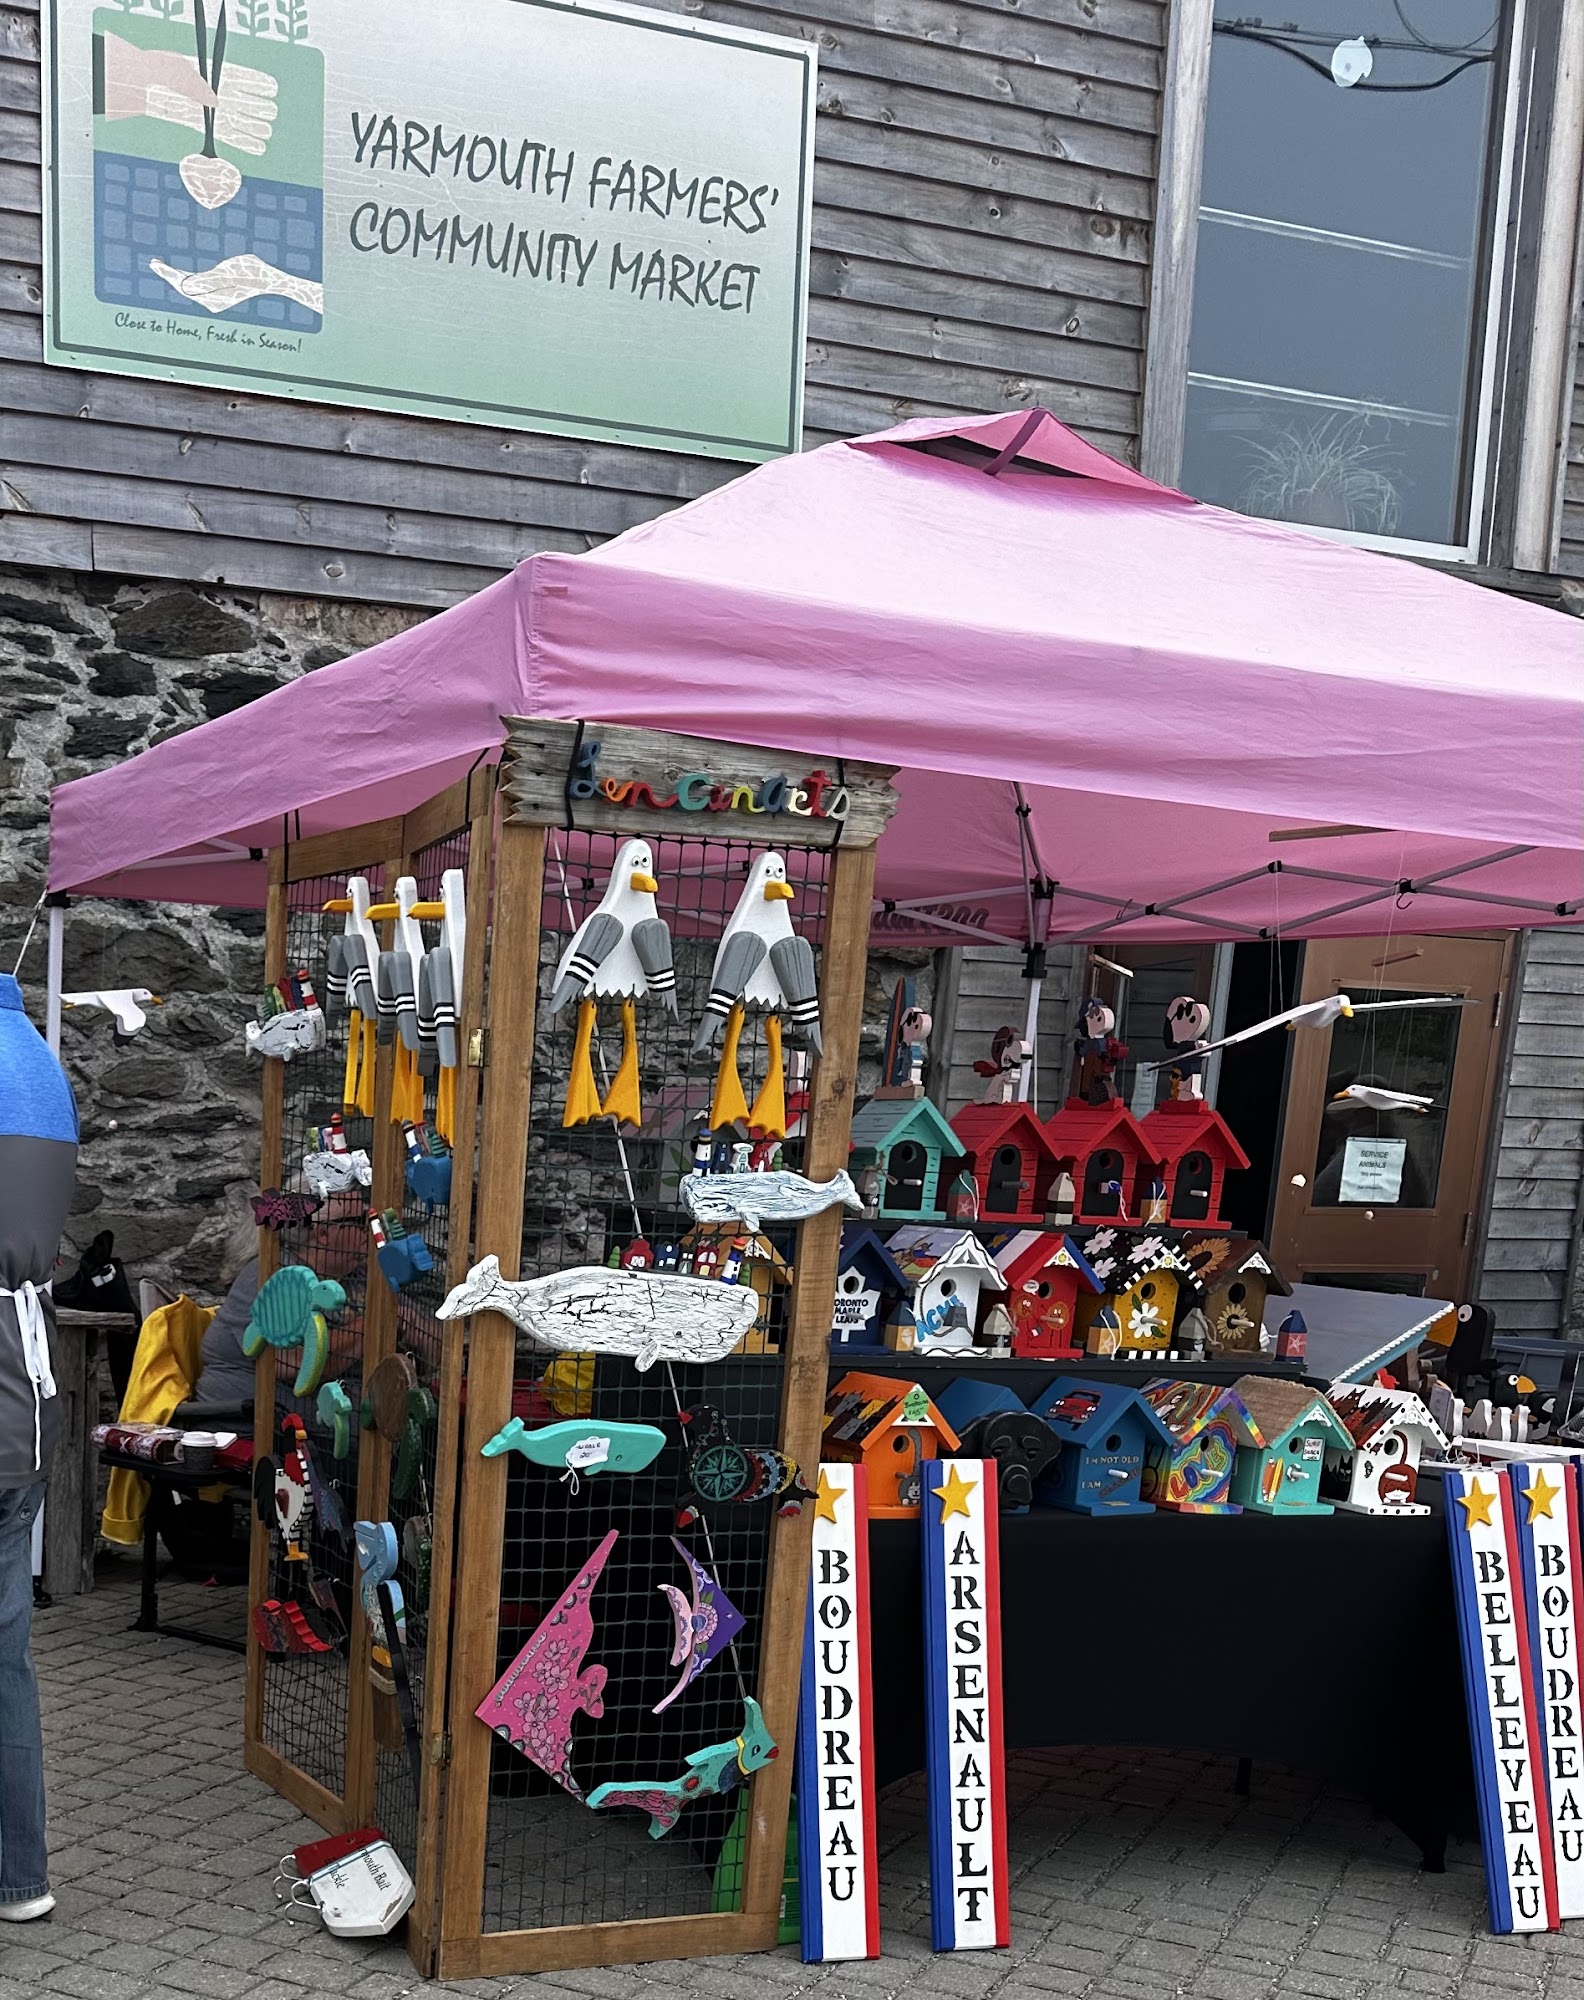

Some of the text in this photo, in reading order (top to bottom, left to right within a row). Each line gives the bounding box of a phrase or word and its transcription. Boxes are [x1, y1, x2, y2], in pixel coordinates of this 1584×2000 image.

[352, 112, 779, 234] YARMOUTH FARMERS'
[350, 202, 760, 313] COMMUNITY MARKET
[115, 312, 302, 353] Close to Home, Fresh in Season!
[1358, 1160, 1387, 1169] ANIMALS
[1360, 1150, 1389, 1159] SERVICE
[834, 1298, 869, 1307] ORONTO
[1100, 1456, 1119, 1464] NOT
[1121, 1455, 1140, 1464] OLD
[1087, 1480, 1101, 1489] AM
[1537, 1544, 1583, 1862] BOUDREAU
[817, 1548, 856, 1903] BOUDREAU
[948, 1530, 989, 1922] ARSENAULT
[1475, 1550, 1541, 1919] BELLEVEAU
[373, 1871, 392, 1891] Bait
